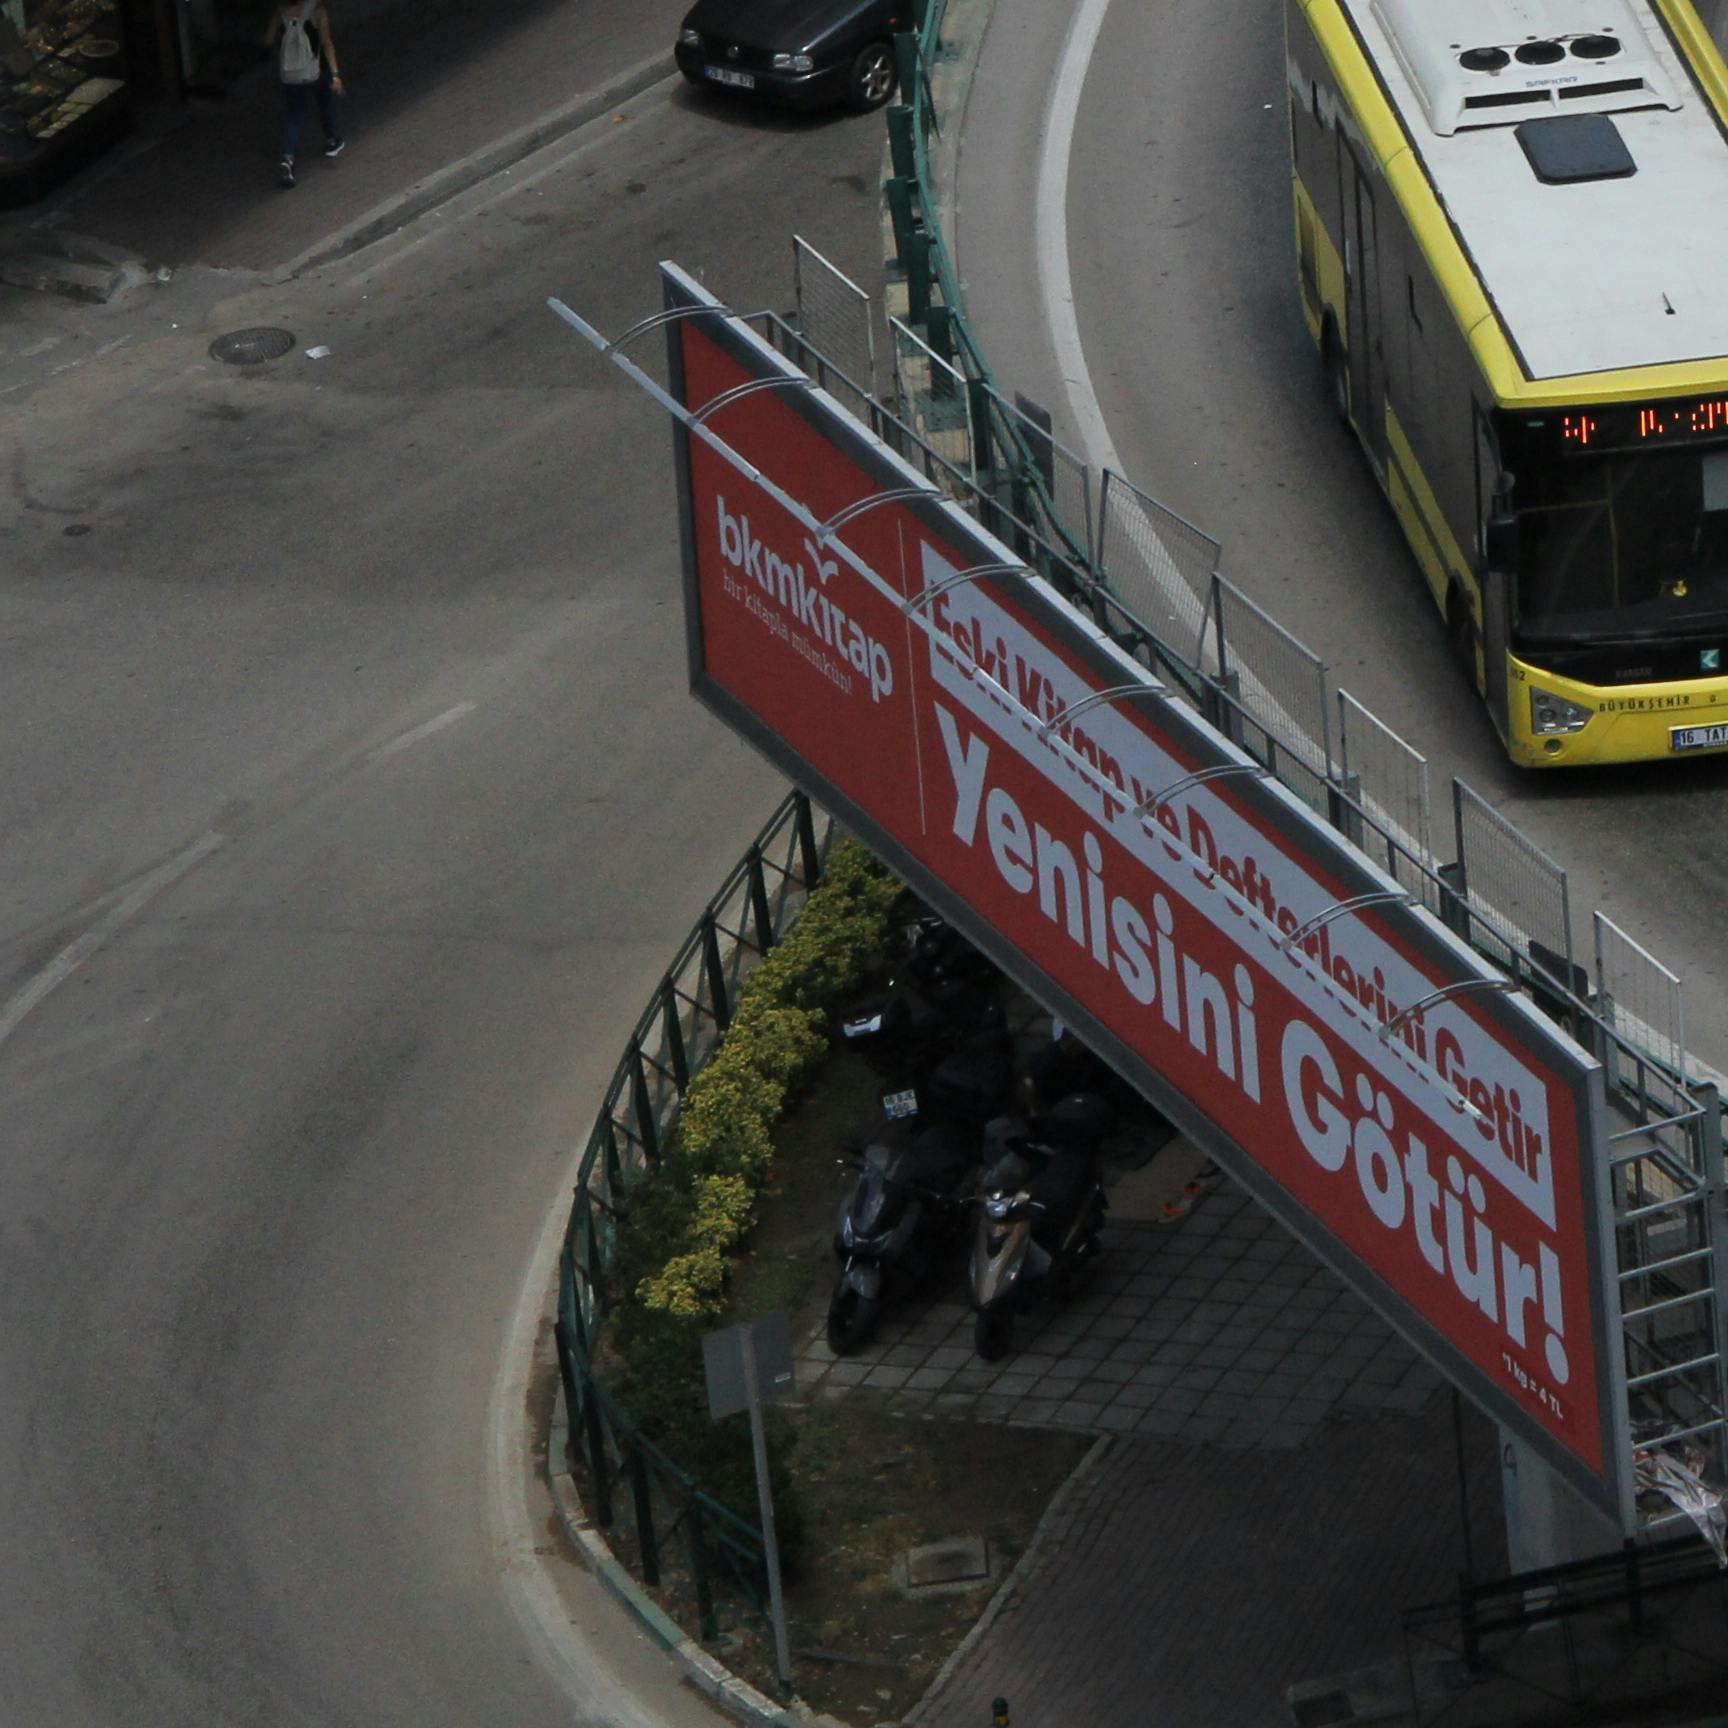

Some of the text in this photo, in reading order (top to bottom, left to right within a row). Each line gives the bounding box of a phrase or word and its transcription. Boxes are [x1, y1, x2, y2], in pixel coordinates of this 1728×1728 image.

[1599, 694, 1691, 713] BÜYÜKŞEHİR
[1680, 730, 1695, 746] 16
[1704, 726, 1728, 740] TAT
[933, 700, 1570, 1385] Yenisini Götür!
[1433, 1025, 1544, 1186] Getir
[1548, 1393, 1564, 1420] TL
